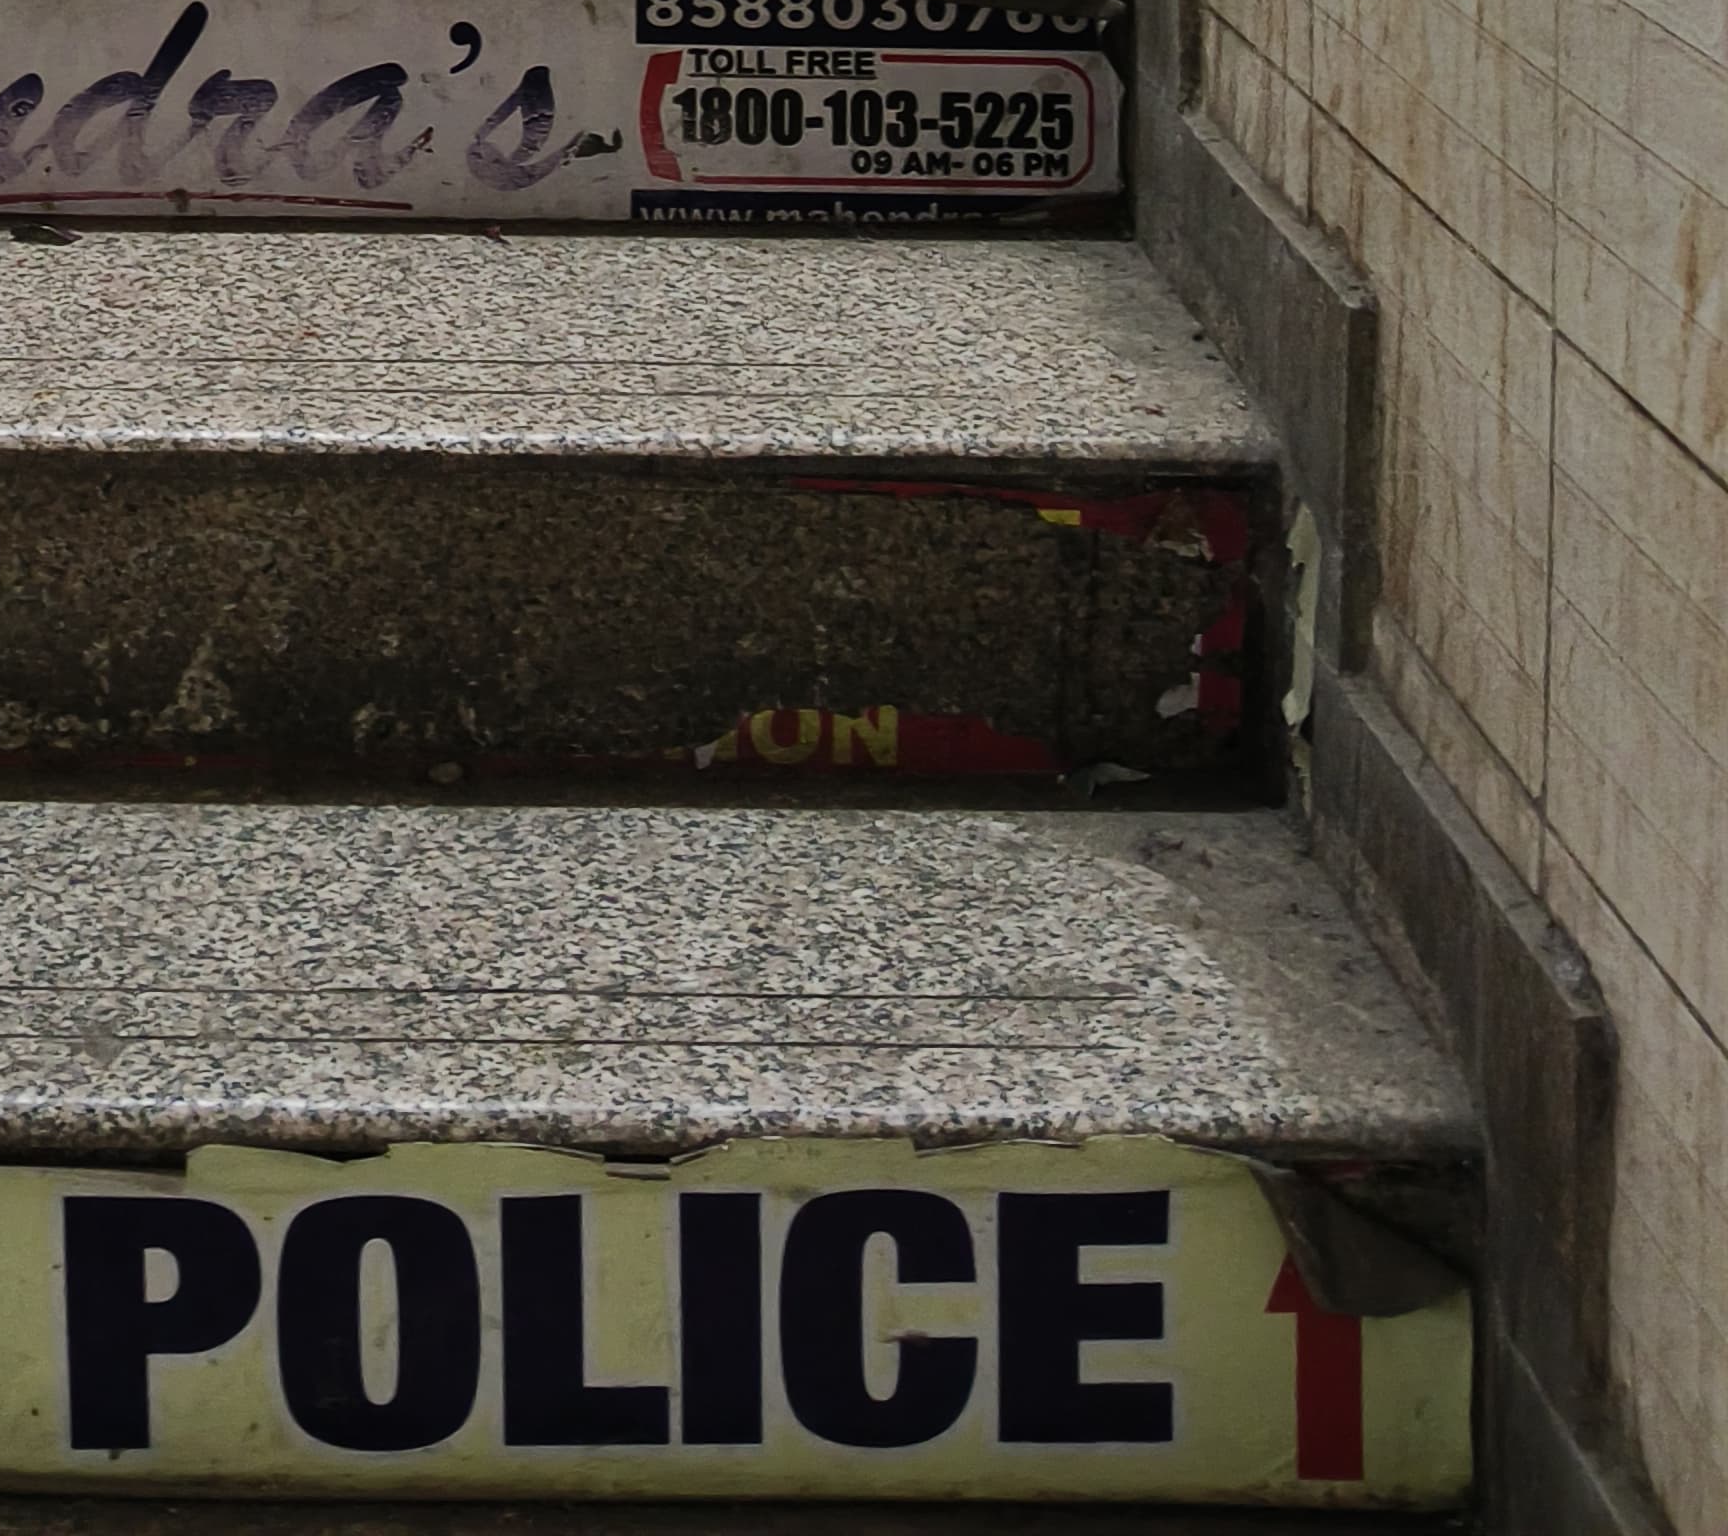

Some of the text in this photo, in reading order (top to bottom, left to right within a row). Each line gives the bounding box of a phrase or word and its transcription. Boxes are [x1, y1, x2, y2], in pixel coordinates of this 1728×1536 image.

[688, 50, 876, 75] TOLL FREE
[672, 88, 1074, 149] 1800-103-5225
[852, 151, 890, 175] 09
[974, 152, 1014, 176] 06
[1024, 153, 1069, 176] PM
[65, 1188, 1172, 1453] POLICE
